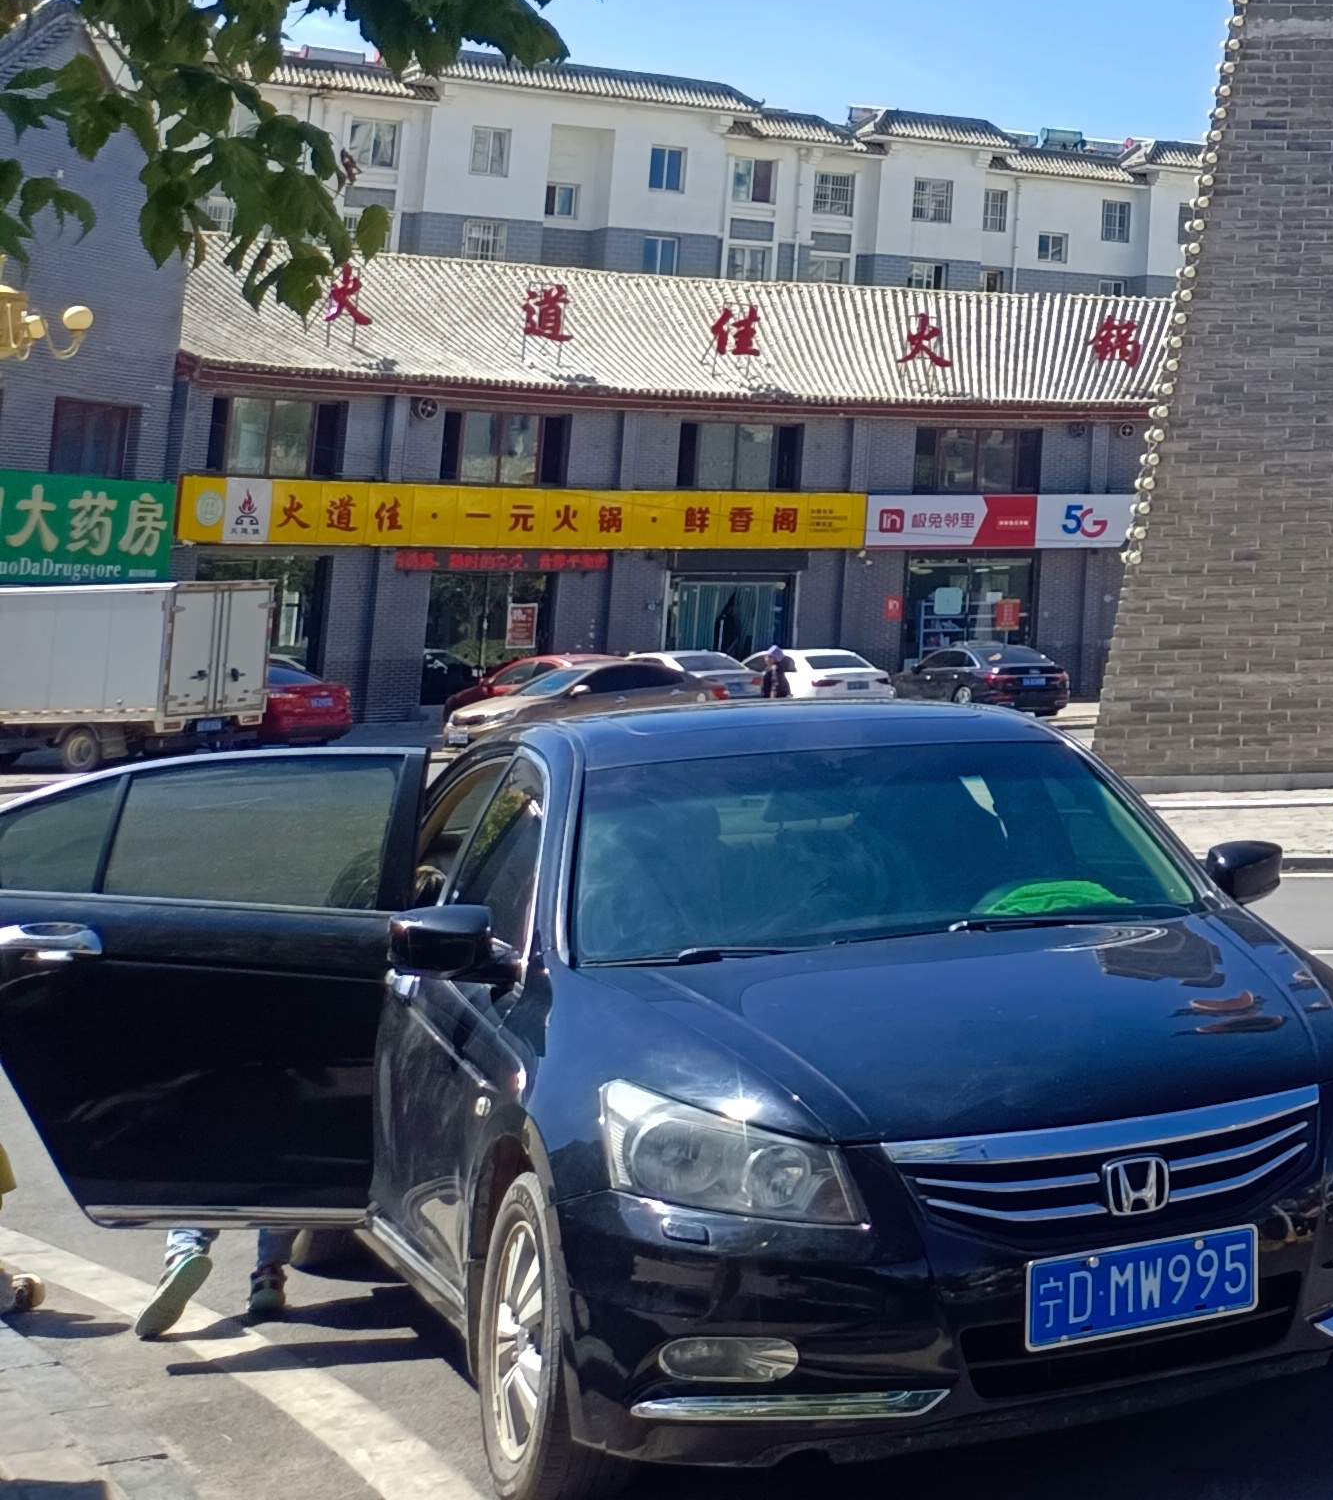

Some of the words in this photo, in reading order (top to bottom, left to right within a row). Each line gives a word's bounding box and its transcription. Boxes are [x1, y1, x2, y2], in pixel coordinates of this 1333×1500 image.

[0, 484, 168, 557] 大药房
[1061, 505, 1108, 538] 5G
